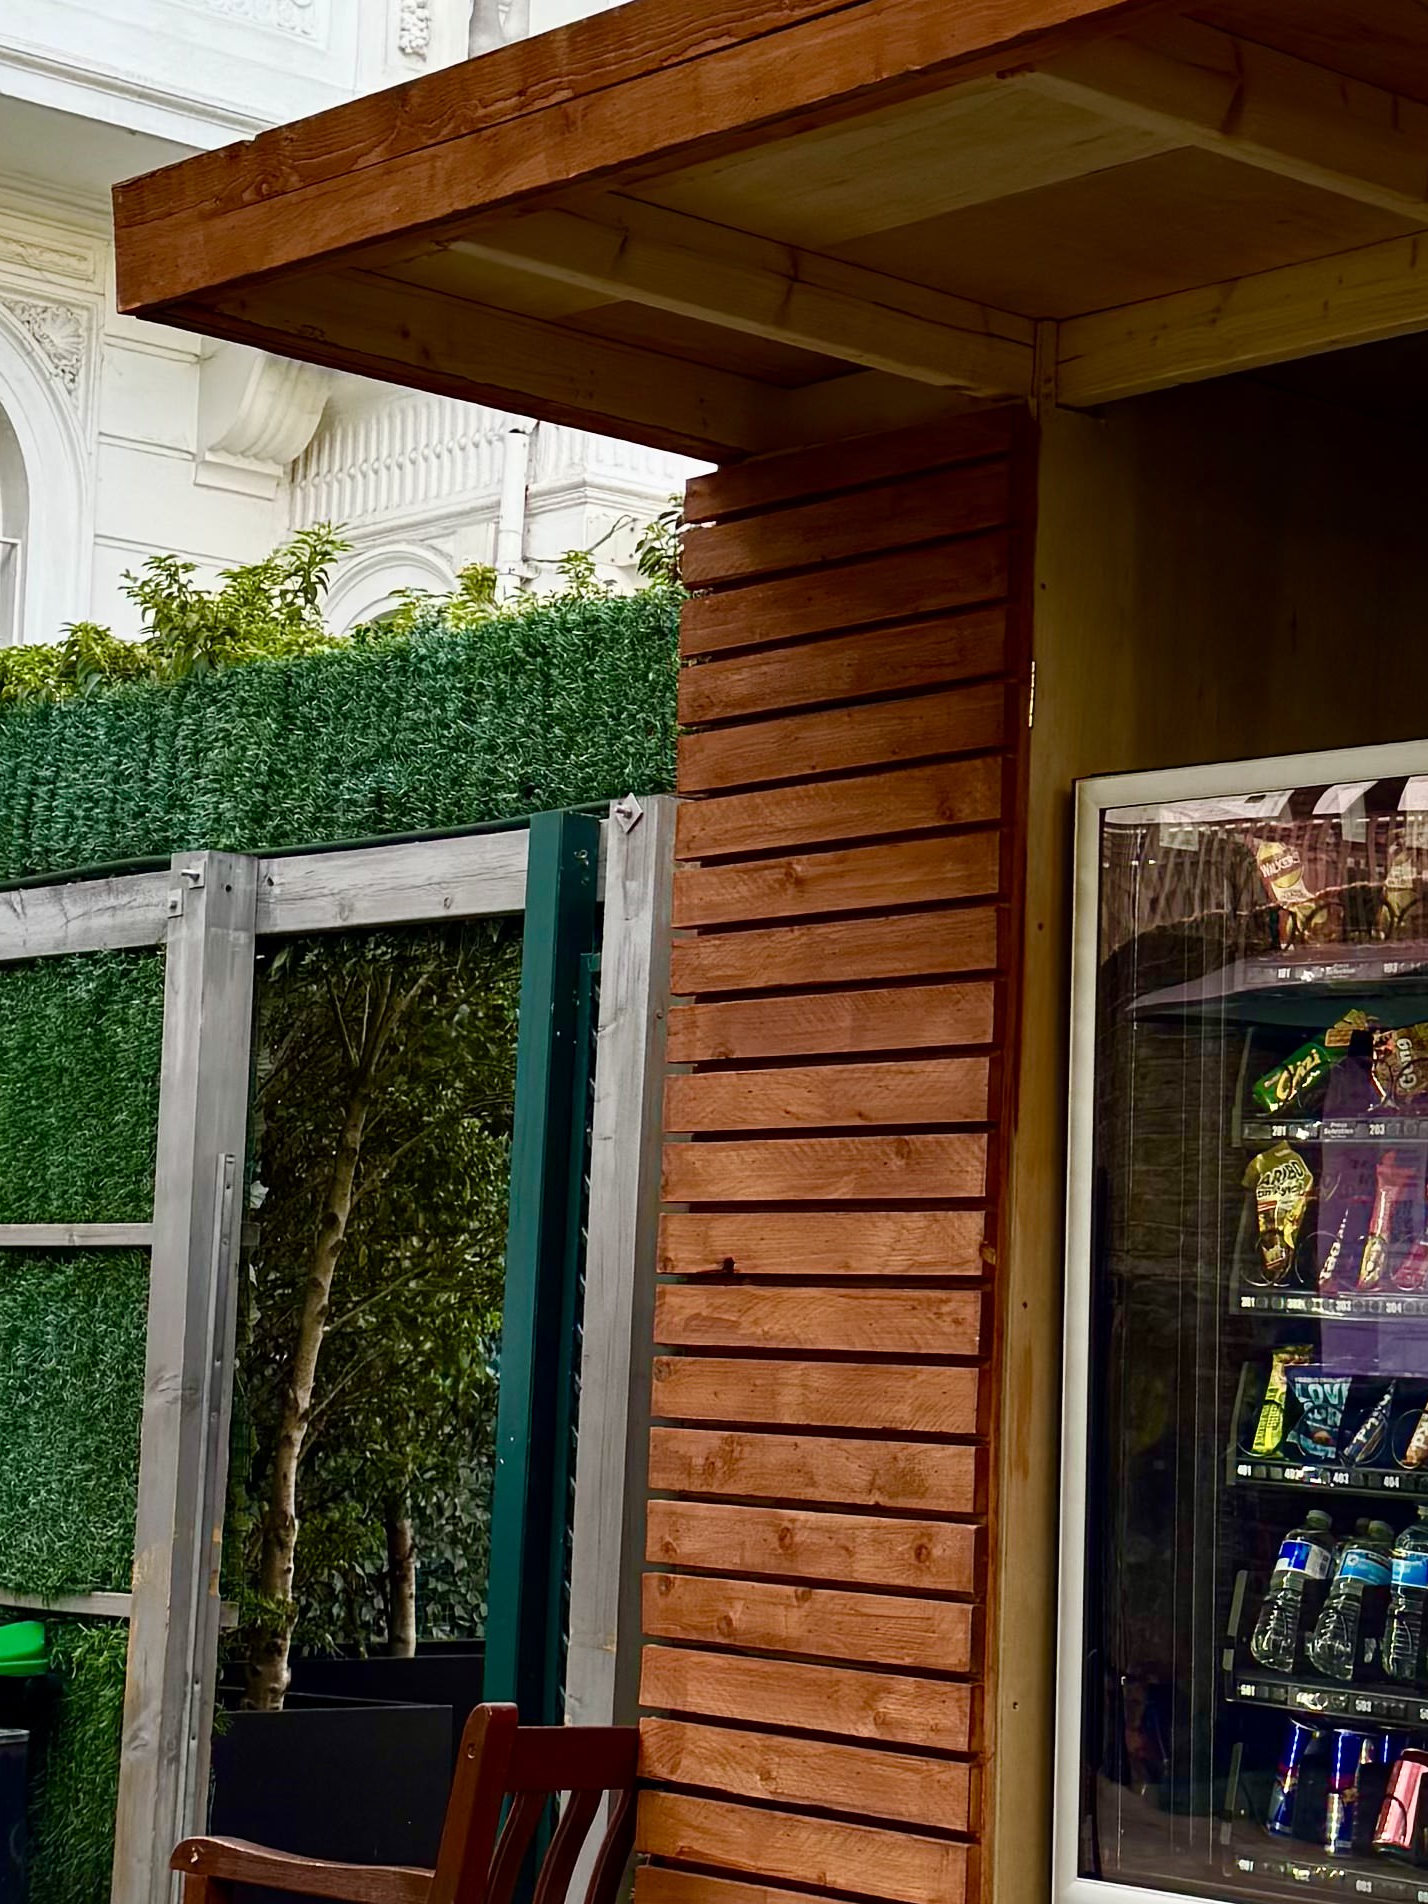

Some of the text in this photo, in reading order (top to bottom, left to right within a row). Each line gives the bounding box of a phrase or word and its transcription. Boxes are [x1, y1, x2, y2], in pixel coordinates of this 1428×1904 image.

[1259, 851, 1301, 878] WALKERS
[1256, 1159, 1305, 1187] ARIBO
[1333, 1472, 1349, 1484] 403
